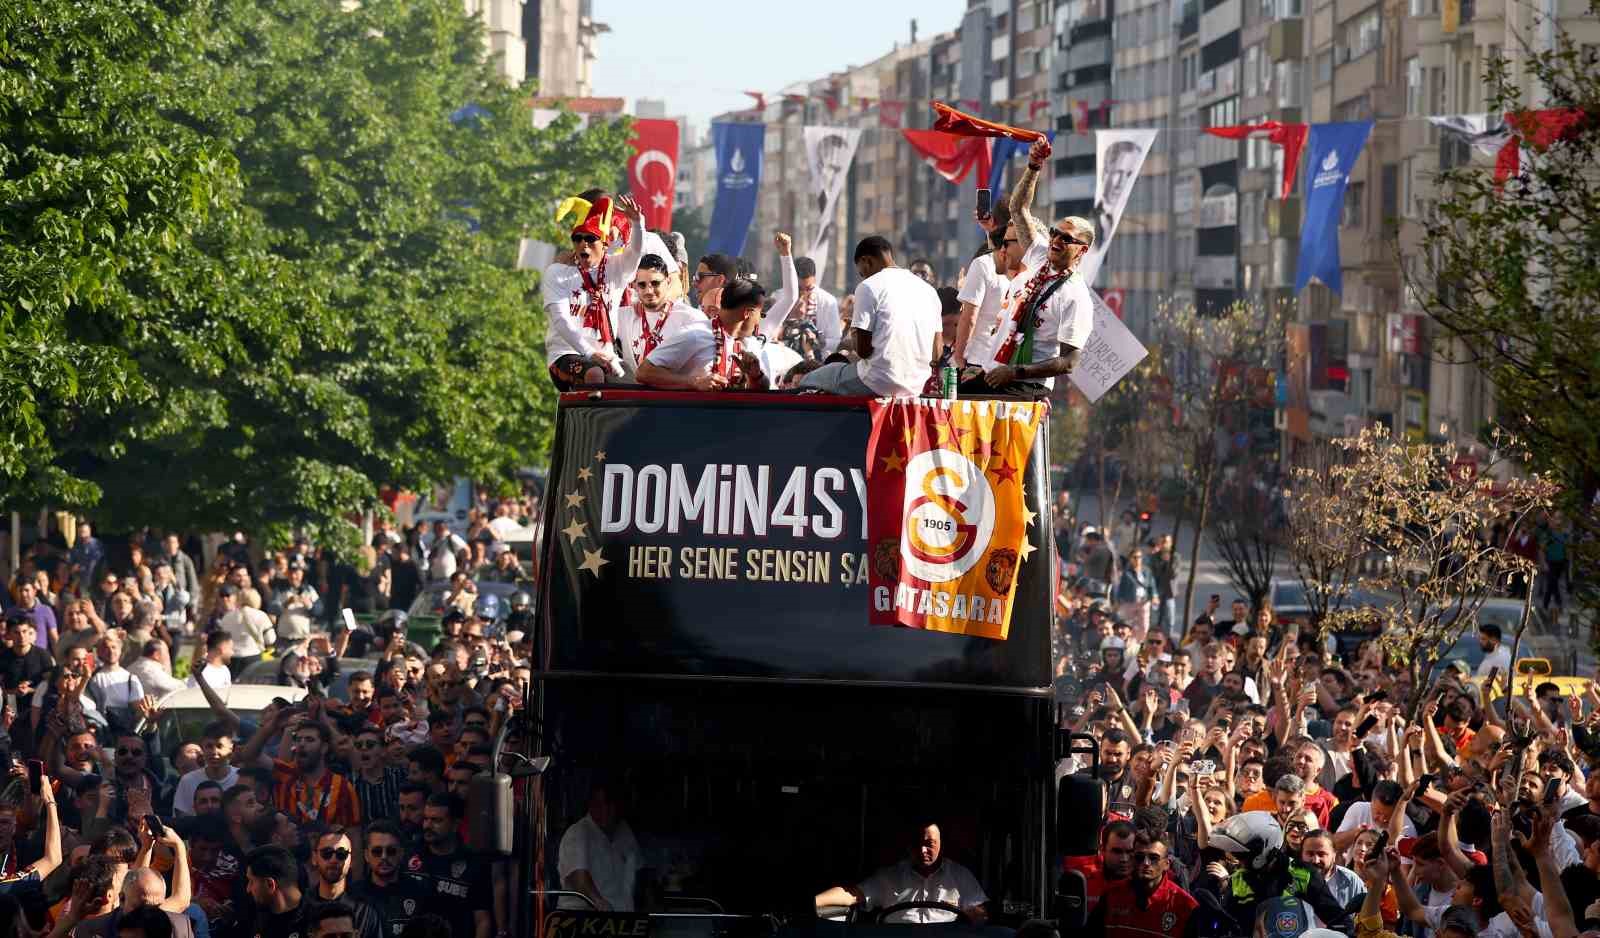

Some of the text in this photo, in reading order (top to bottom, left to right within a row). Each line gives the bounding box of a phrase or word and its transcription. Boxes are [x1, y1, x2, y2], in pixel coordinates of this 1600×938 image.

[923, 518, 952, 531] 1905
[628, 546, 673, 579] HER
[680, 547, 738, 580] SENE
[580, 916, 649, 937] KALE
